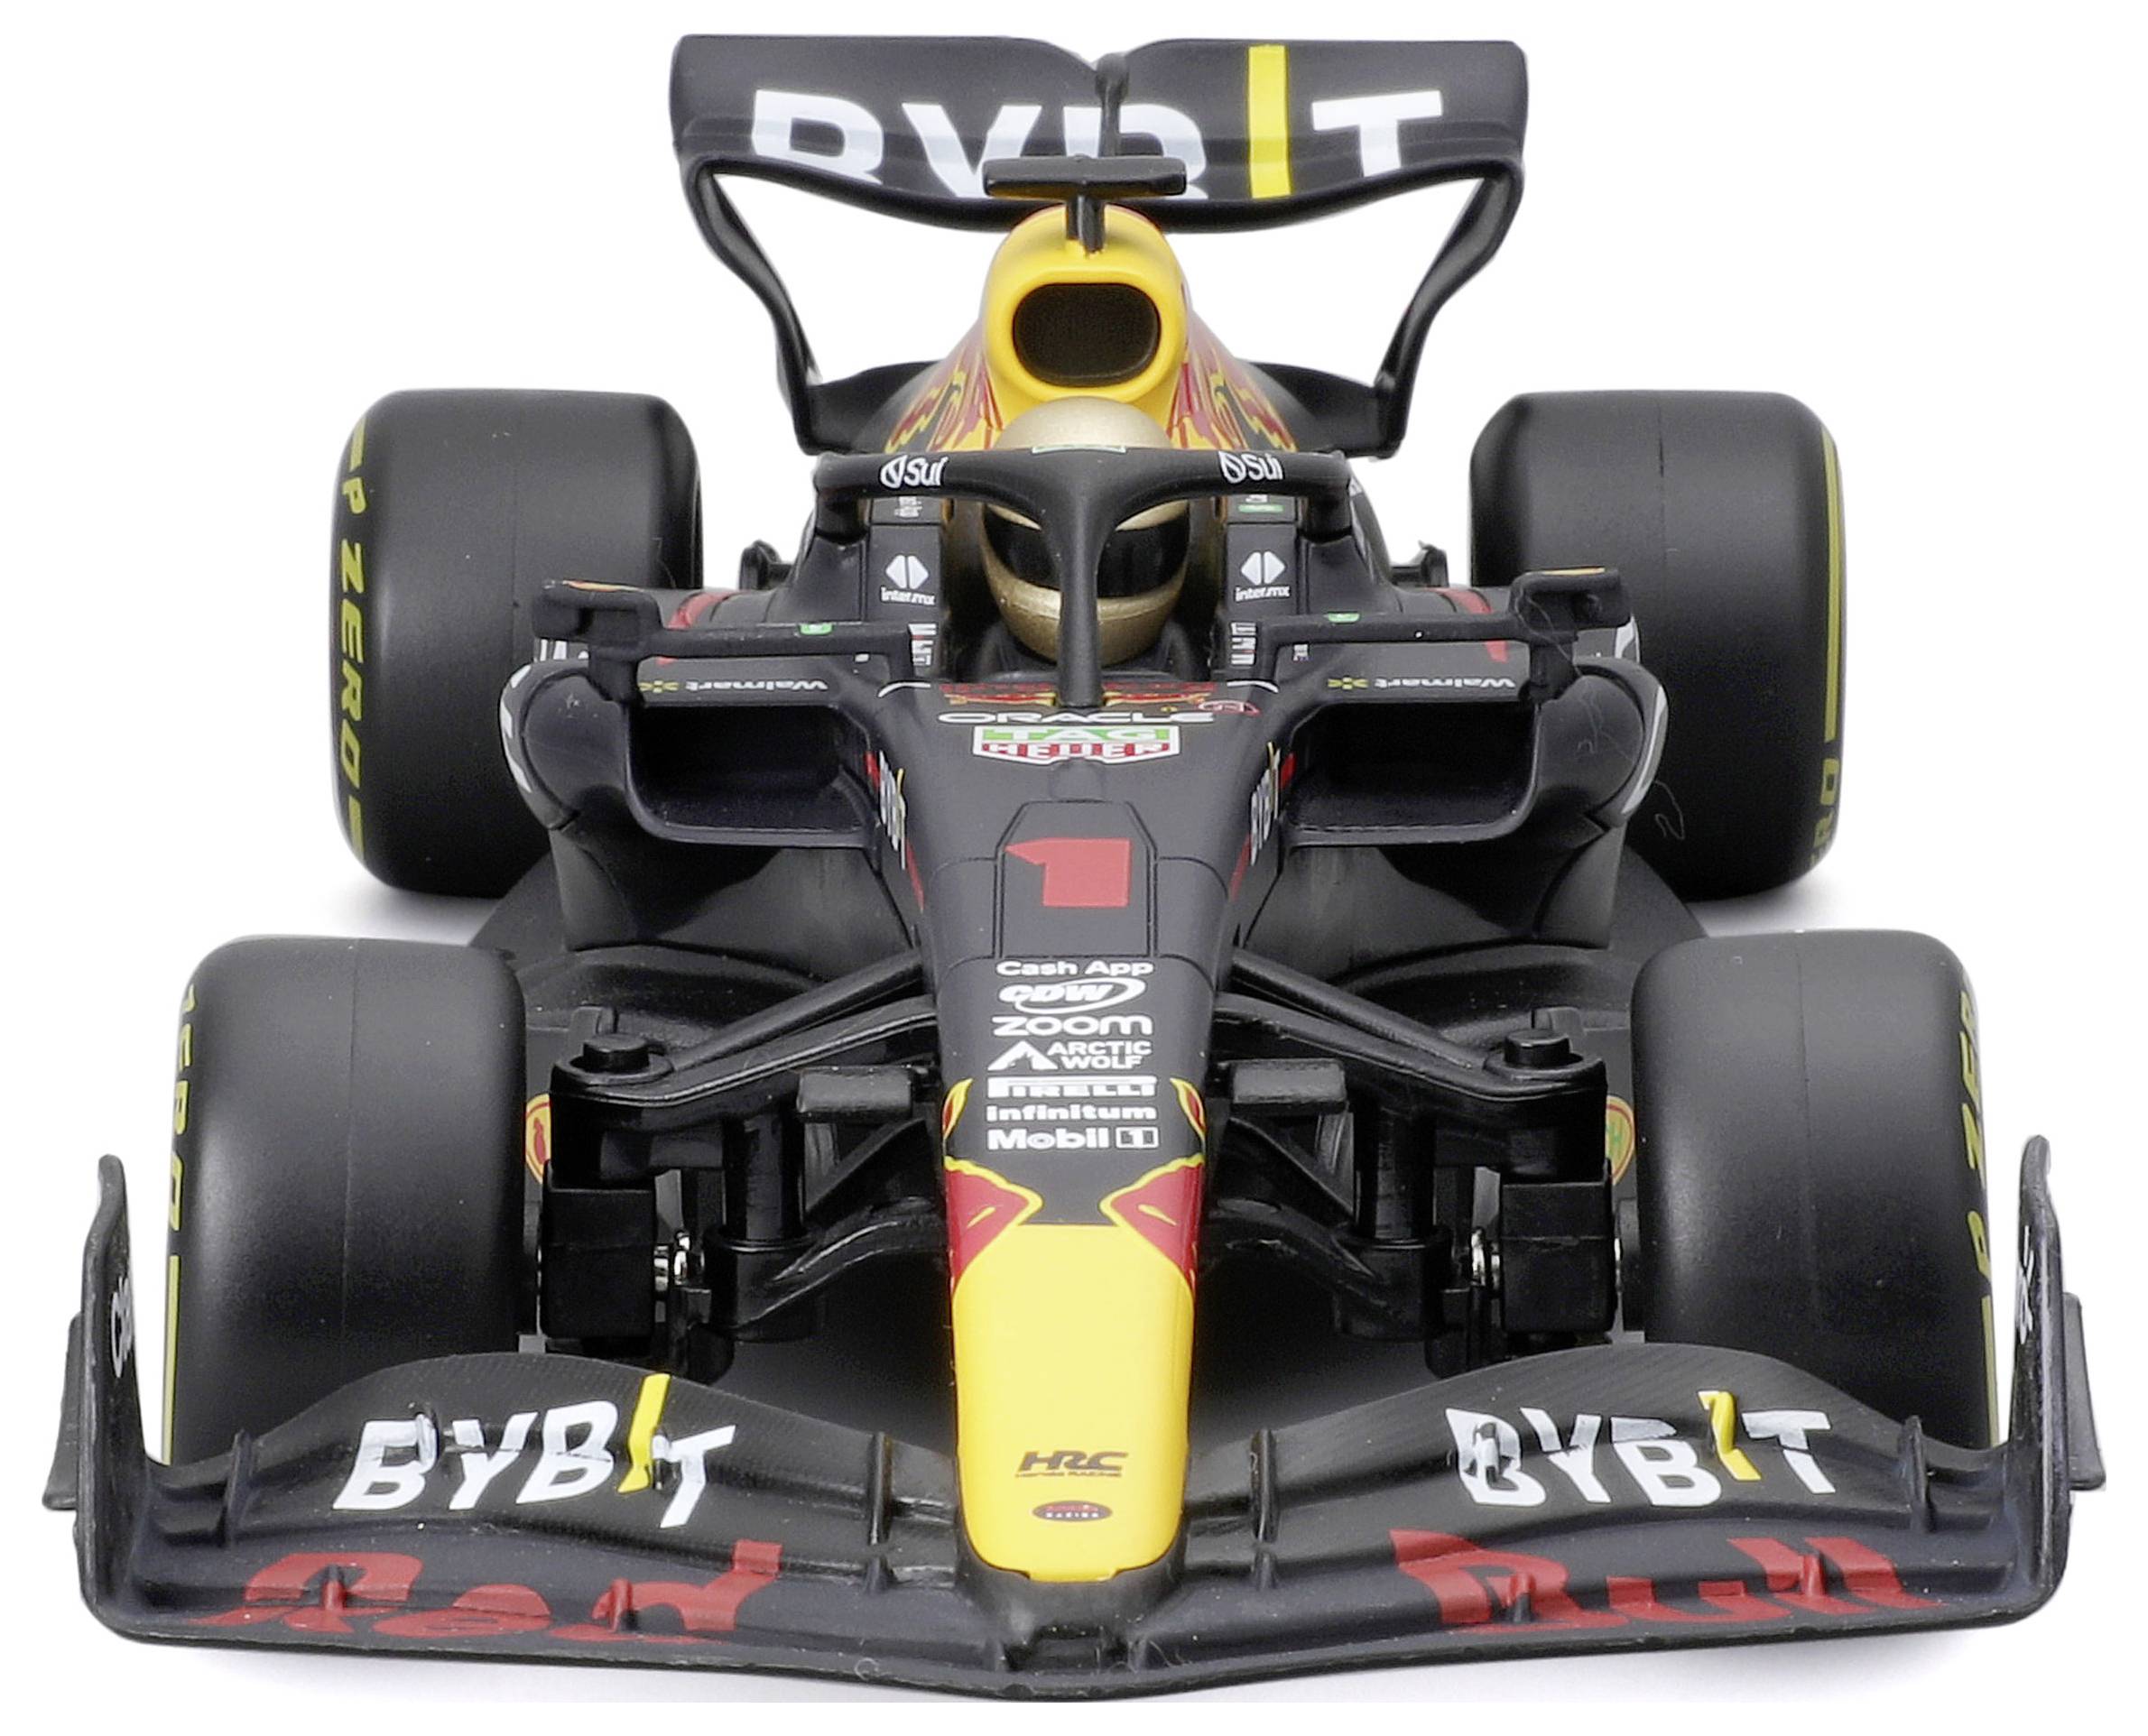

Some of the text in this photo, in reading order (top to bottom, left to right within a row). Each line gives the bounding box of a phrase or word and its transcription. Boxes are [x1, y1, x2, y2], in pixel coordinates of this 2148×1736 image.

[340, 538, 365, 790] ZERO
[938, 712, 1214, 724] ORACLE
[999, 729, 1158, 741] TAG
[1005, 837, 1132, 908] 1
[995, 960, 1154, 976] Cash App
[992, 1015, 1153, 1036] zoom
[1047, 1040, 1153, 1056] ARCTIC
[1060, 1056, 1143, 1069] WOLF
[987, 1076, 1158, 1099] PIRELLI
[987, 1127, 1160, 1150] Mobil 1
[332, 1372, 736, 1528] BYBIT
[1446, 1390, 1836, 1508] BYBIT
[1018, 1450, 1128, 1472] HRC
